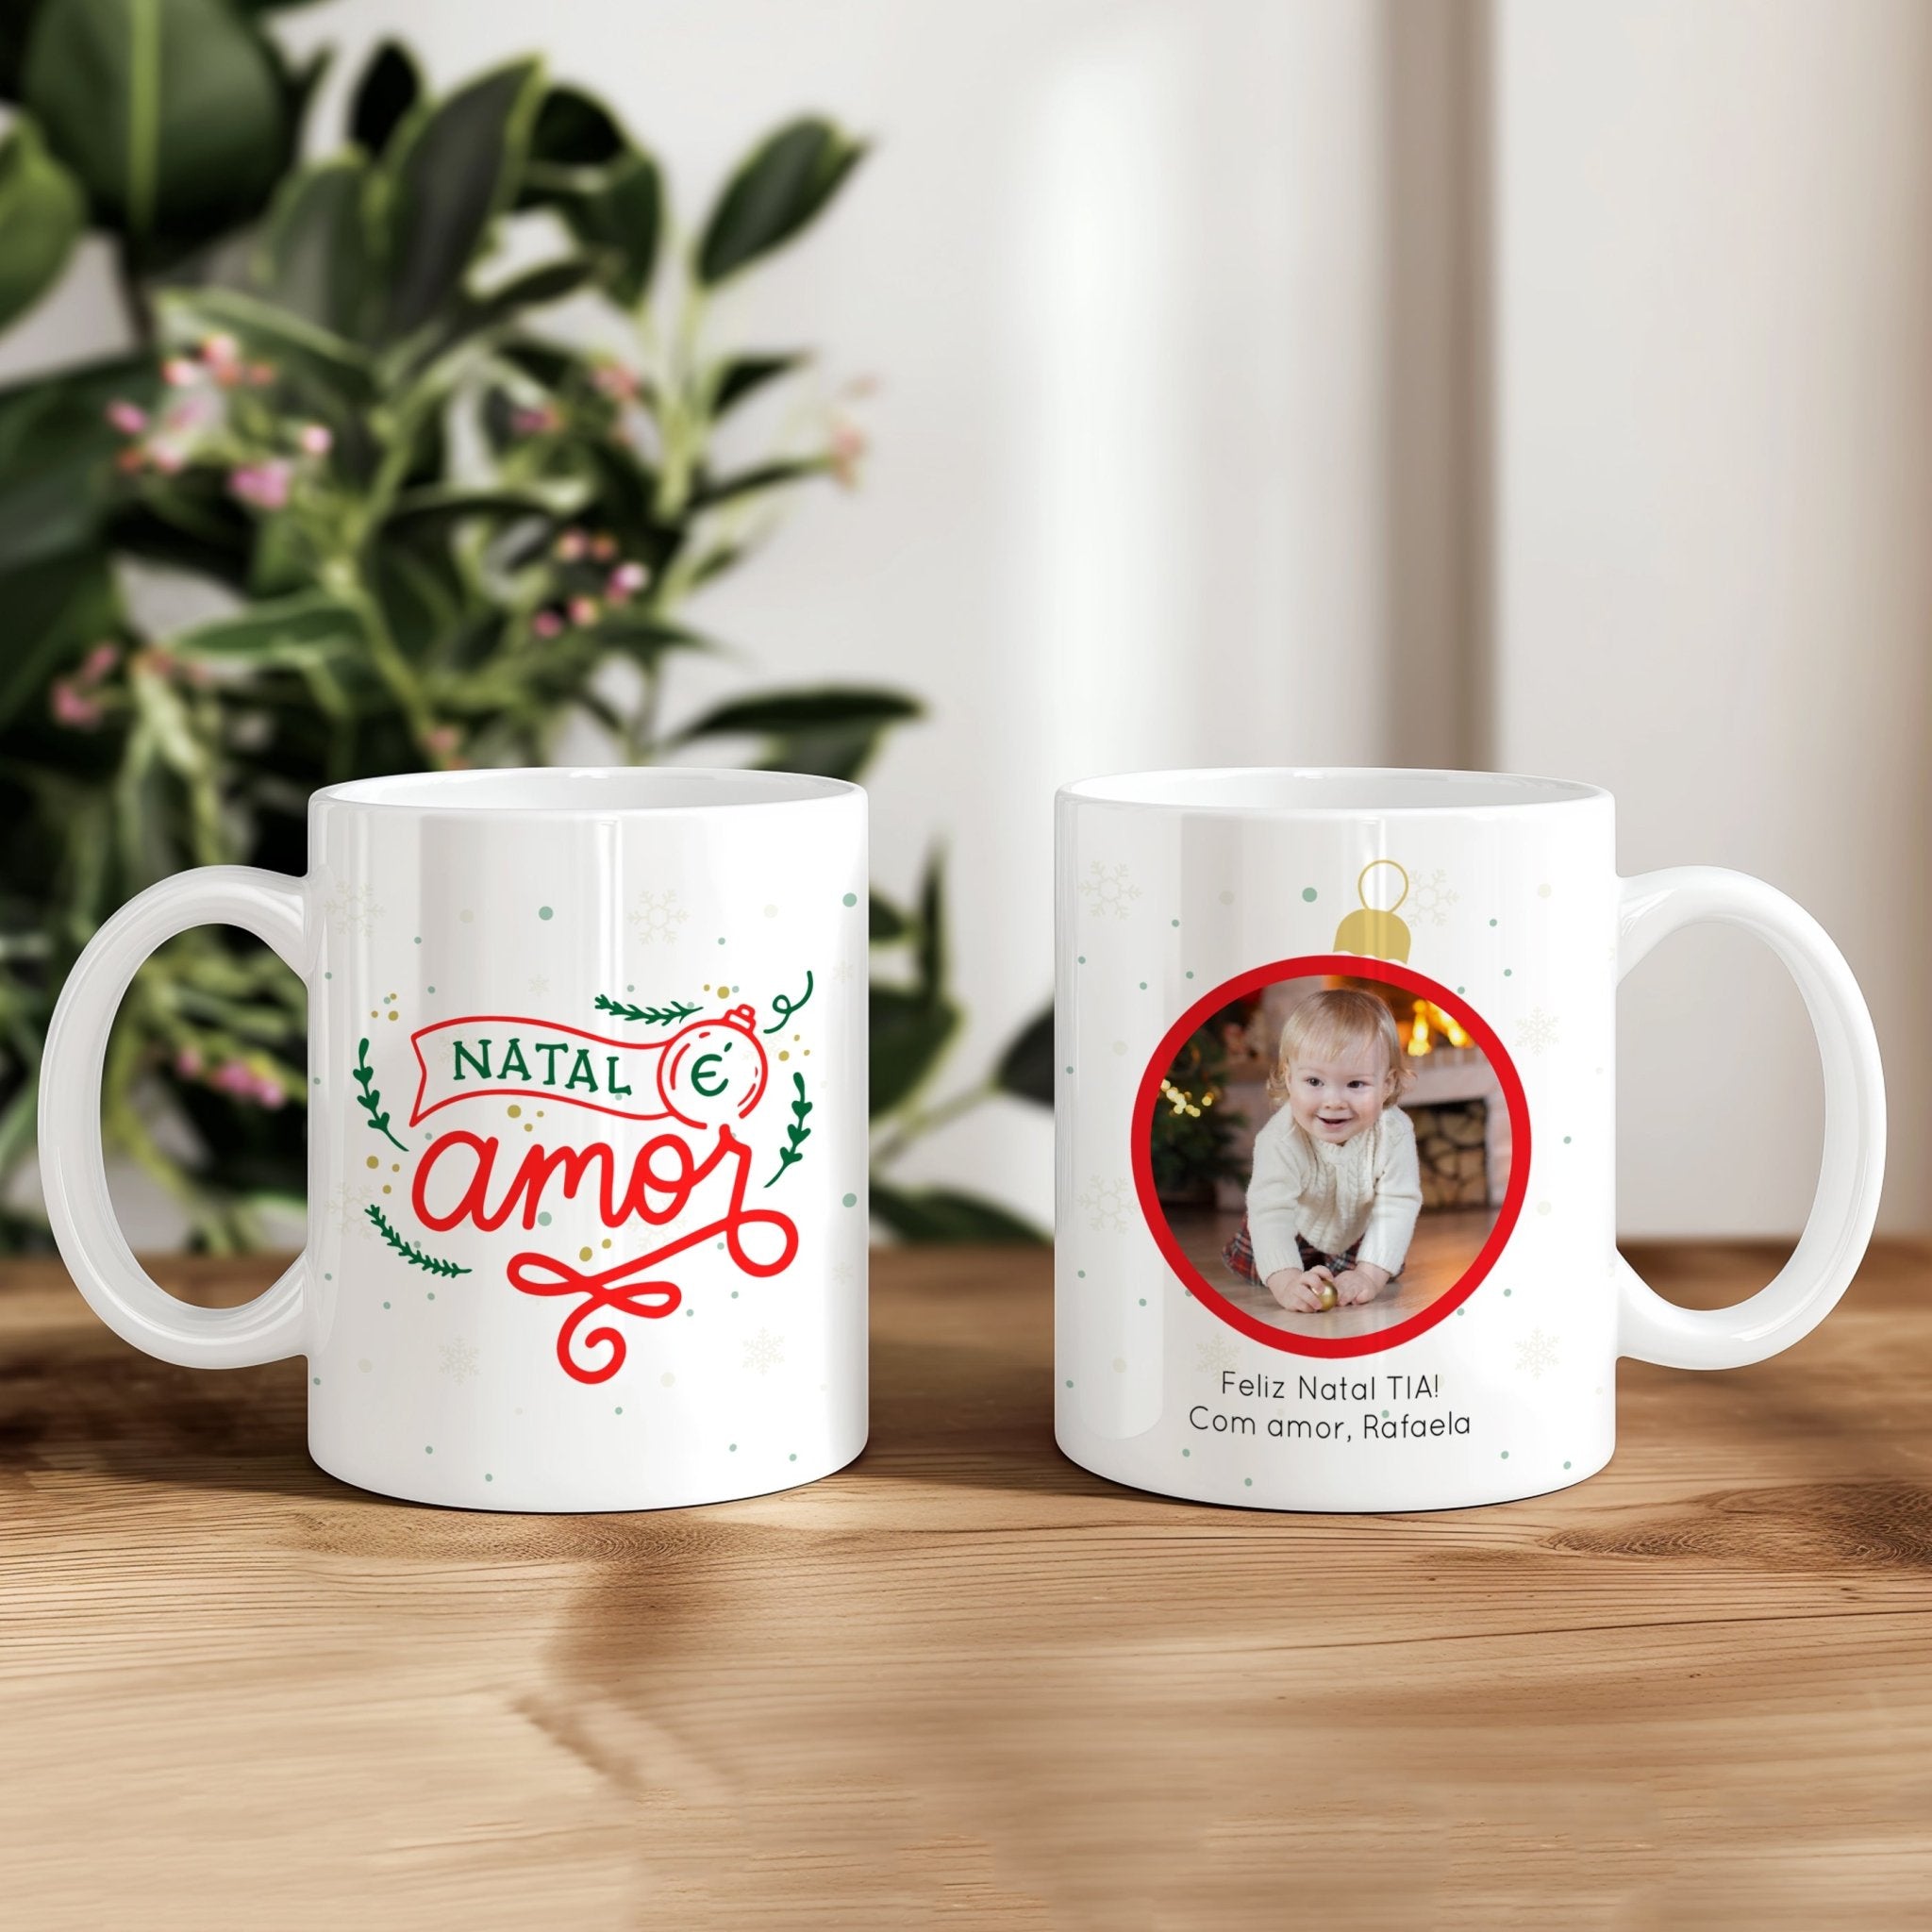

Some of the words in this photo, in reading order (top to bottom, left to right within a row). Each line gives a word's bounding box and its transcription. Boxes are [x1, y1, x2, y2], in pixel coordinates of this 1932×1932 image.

[452, 1038, 632, 1096] NATAL
[411, 1124, 799, 1278] amor
[1222, 1371, 1285, 1398] Feliz
[1299, 1375, 1375, 1400] Natal
[1387, 1374, 1440, 1400] TIA!
[1190, 1406, 1256, 1435] Com
[1268, 1419, 1352, 1442] amor,
[1364, 1411, 1471, 1439] Rafaela
